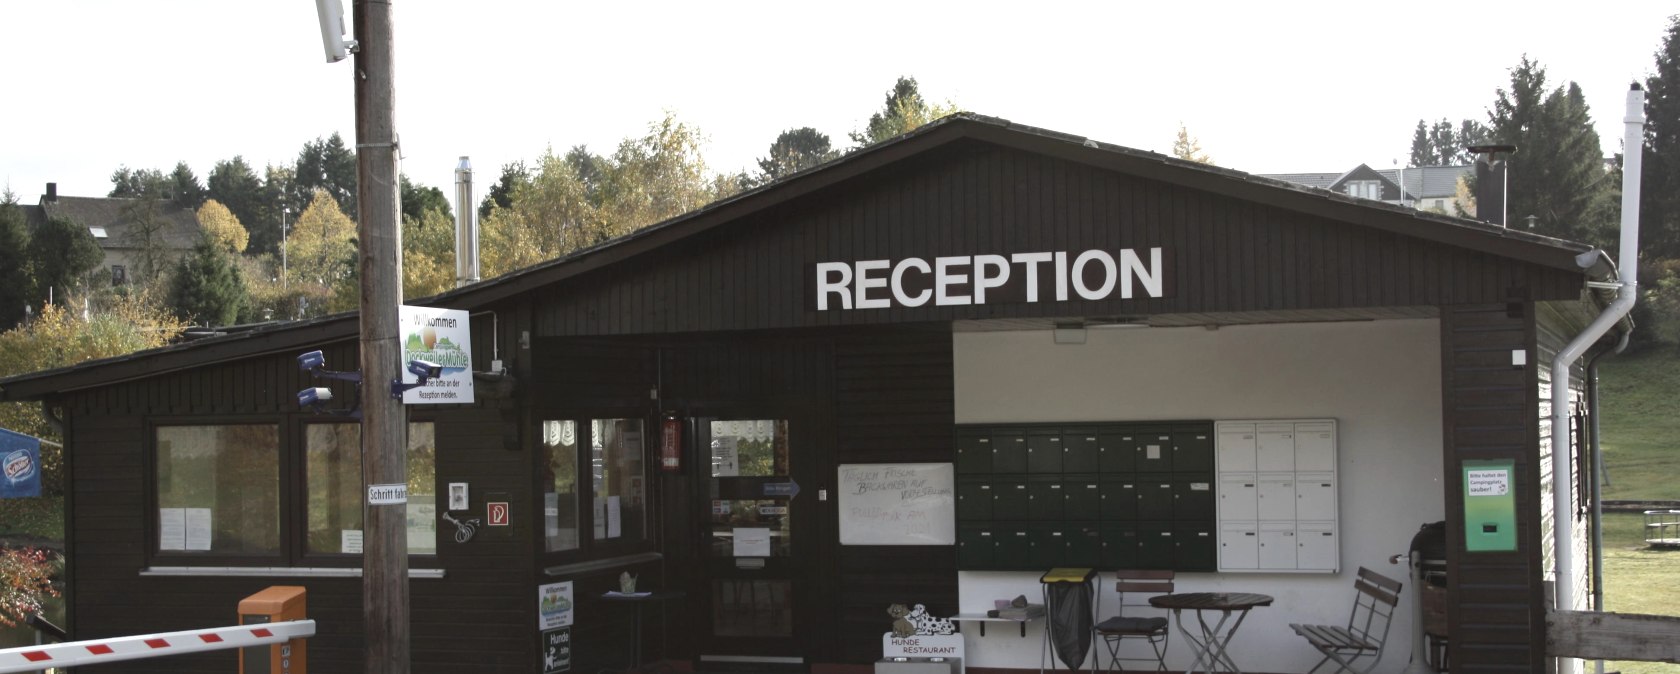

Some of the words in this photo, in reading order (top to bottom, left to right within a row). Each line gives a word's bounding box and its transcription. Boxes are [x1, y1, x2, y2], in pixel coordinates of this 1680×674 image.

[816, 247, 1163, 311] RECEPTION
[413, 313, 457, 329] Willkommen
[436, 378, 446, 387] bitte
[419, 390, 441, 400] Rezeption
[441, 390, 458, 399] melden.
[370, 488, 393, 500] Schritt
[550, 632, 569, 645] Hunde
[891, 638, 920, 646] HUNDE
[903, 646, 956, 654] RESTAURANT
